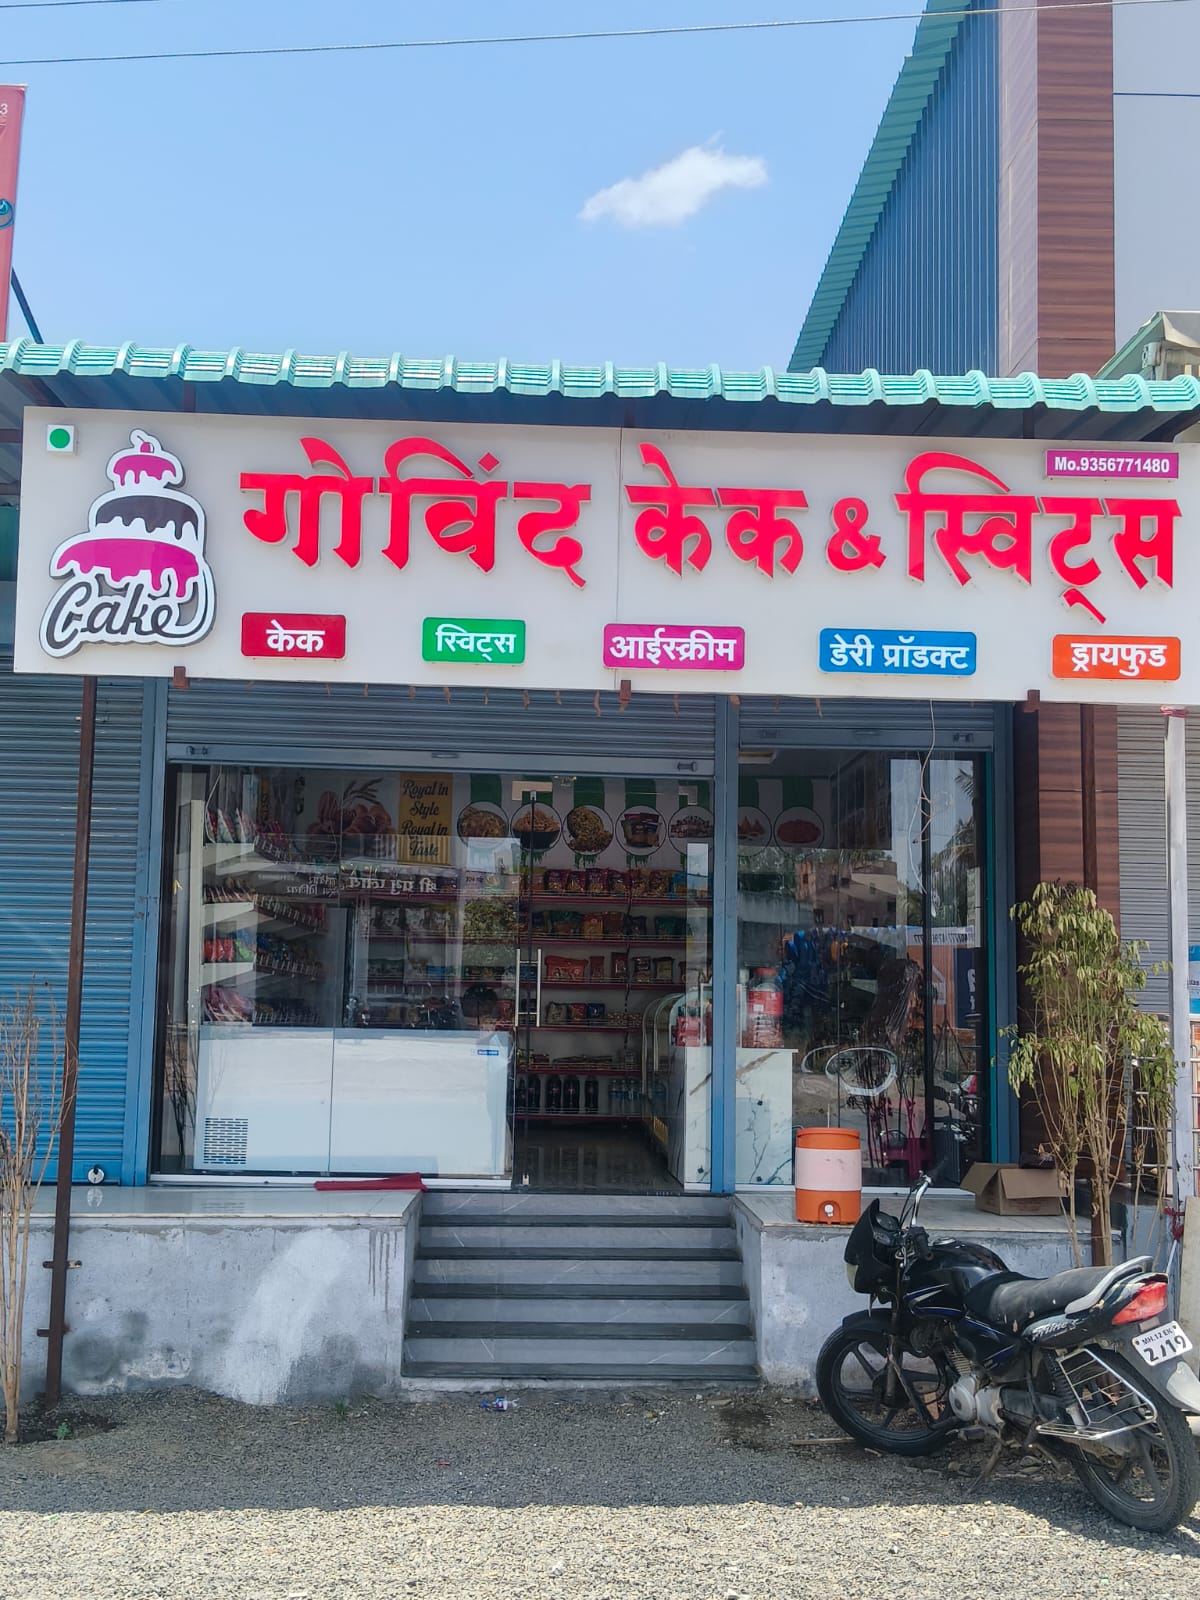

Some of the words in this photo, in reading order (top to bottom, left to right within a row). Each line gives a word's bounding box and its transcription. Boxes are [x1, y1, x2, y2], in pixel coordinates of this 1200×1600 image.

[1055, 457, 1170, 473] Mo.9356771480
[240, 437, 591, 588] गोविंद
[625, 443, 808, 578] केक
[827, 497, 887, 572] &
[895, 451, 1182, 624] स्विट्स
[46, 572, 209, 650] Cake
[266, 620, 325, 652] केक
[435, 623, 516, 661] स्विट्स
[610, 628, 737, 663] आईस्क्रीम
[830, 634, 874, 668] डेरी
[882, 635, 970, 670] प्रॉडक्ट
[1070, 643, 1168, 677] ड्रायफुड
[402, 779, 436, 799] Royal
[438, 783, 448, 796] in
[409, 801, 440, 819] Style
[400, 819, 436, 839] Royal
[438, 823, 448, 836] in
[409, 840, 438, 857] Taste
